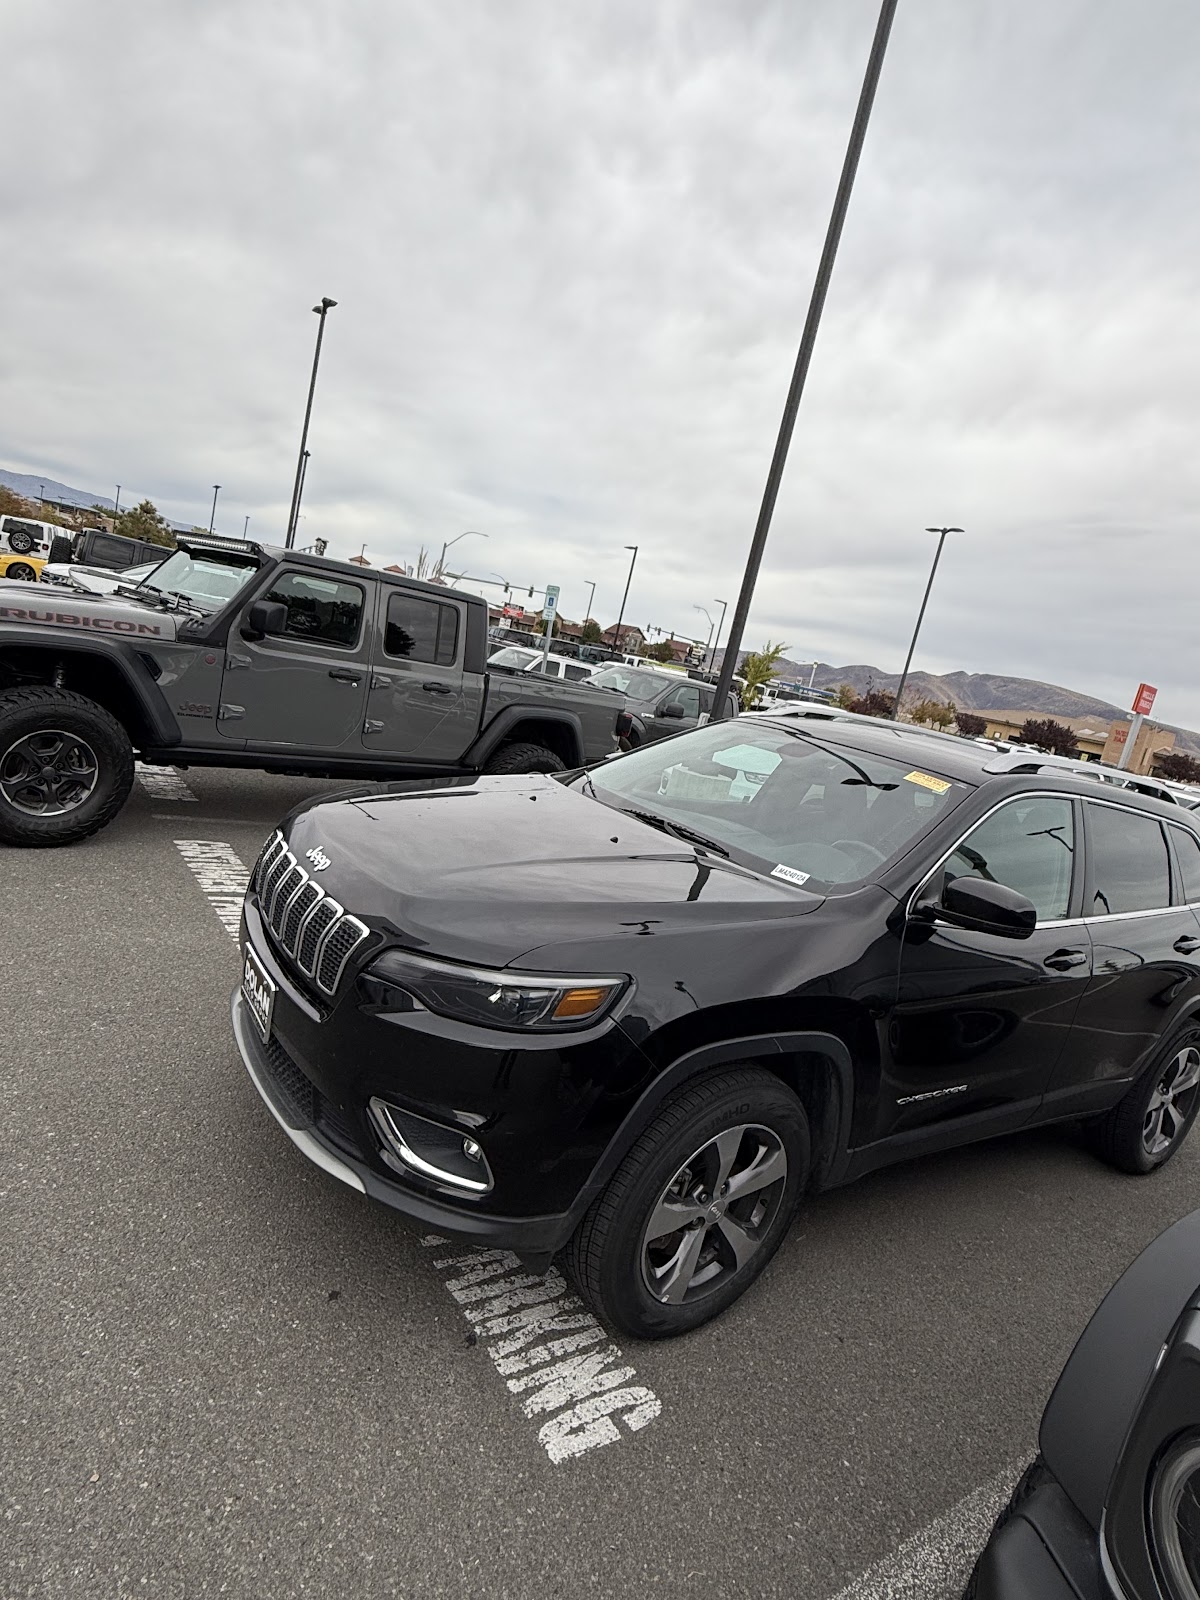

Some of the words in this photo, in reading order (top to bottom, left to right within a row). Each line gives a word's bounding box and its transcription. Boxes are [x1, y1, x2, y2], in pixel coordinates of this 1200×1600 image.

[0, 607, 161, 635] RUBICON
[179, 700, 212, 715] Jeep
[306, 846, 332, 871] Jeep
[245, 959, 270, 1017] DOLAN
[419, 1234, 662, 1464] ARKING
